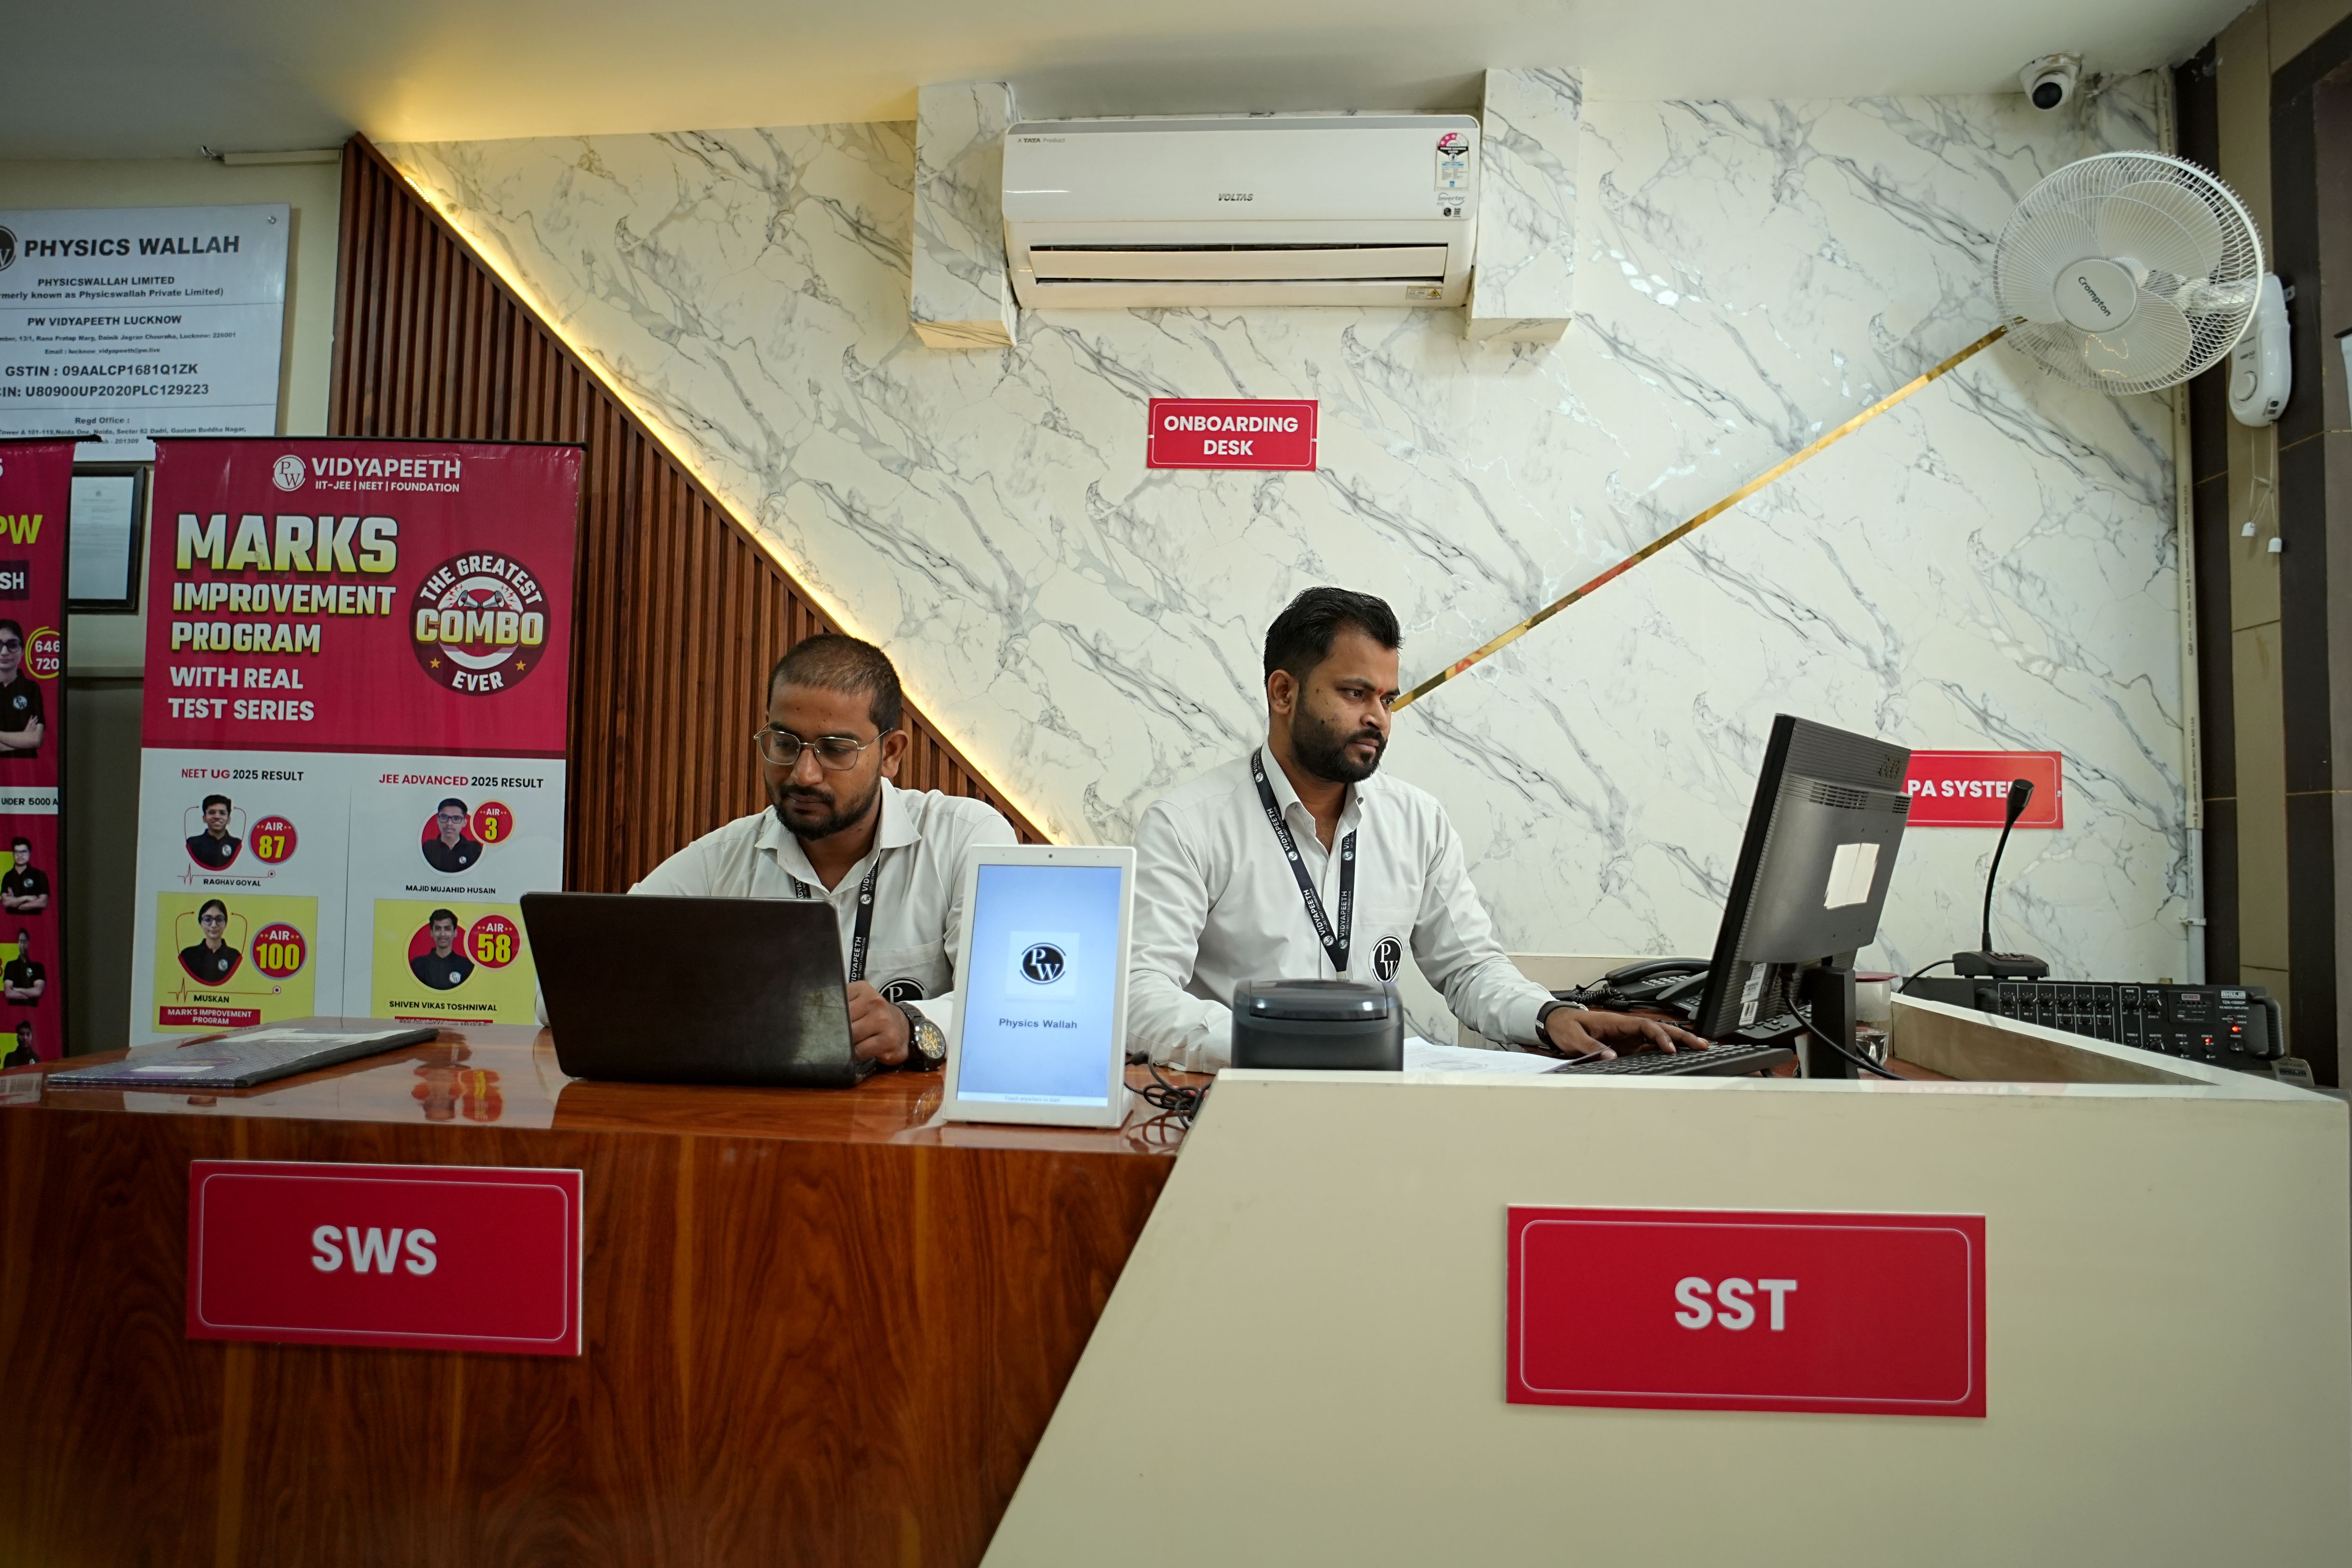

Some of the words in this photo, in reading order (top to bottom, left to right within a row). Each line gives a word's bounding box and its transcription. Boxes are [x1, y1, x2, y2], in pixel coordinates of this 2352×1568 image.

[25, 238, 130, 257] PHYSICS
[139, 235, 240, 255] WALLAH
[38, 278, 128, 287] PHYSICSWALLAH
[131, 276, 175, 285] LIMITED
[79, 290, 146, 300] Physicswallah
[185, 287, 223, 297] Limited)
[2078, 277, 2111, 317] Crompton
[28, 318, 46, 326] PW
[49, 317, 120, 326] VIDYAPEETH
[124, 316, 182, 325] LUCKNOW
[5, 366, 49, 377] GSTIN
[1164, 416, 1298, 432] ONBOARDING
[1204, 440, 1253, 455] DESK
[312, 457, 461, 479] VIDYAPEETH
[316, 481, 351, 490] IIT-JEE
[359, 481, 383, 491] NEET
[391, 482, 460, 493] FOUNDATION
[175, 514, 398, 573] MARKS
[420, 566, 456, 602] THE
[459, 555, 542, 605] GREATEST
[173, 582, 396, 615] IMPROVEMENT
[416, 608, 544, 646] COMBO
[171, 621, 321, 653] PROGRAM
[36, 658, 60, 670] 720
[170, 666, 238, 688] WITH
[244, 668, 303, 689] REAL
[452, 670, 504, 692] EVER
[168, 698, 228, 719] TEST
[233, 700, 315, 721] SERIES
[181, 768, 208, 779] NEET
[211, 769, 230, 780] UG
[233, 769, 258, 780] 2025
[262, 770, 304, 781] RESULT
[379, 773, 399, 784] JEE
[402, 774, 469, 786] ADVANCED
[471, 777, 499, 787] 2025
[501, 777, 544, 788] RESULT
[1907, 780, 1937, 797] PA
[1941, 780, 2013, 798] SYSTE
[486, 808, 500, 816] AIR
[265, 822, 283, 832] AIR
[485, 818, 498, 840] 3
[1267, 808, 1290, 851] VIDYAPEETH
[259, 835, 286, 859] 87
[203, 878, 234, 886] RAGHAV
[405, 884, 429, 893] MAJID
[430, 885, 465, 894] MUJAHID
[1303, 889, 1326, 936] VIDYAPEETH
[270, 930, 290, 941] AIR
[486, 923, 504, 933] AIR
[256, 943, 300, 970] 100
[477, 933, 511, 963] 58
[194, 994, 230, 1003] MUSKAN
[889, 986, 903, 1003] P
[199, 1010, 252, 1018] IMPROVEMENT
[389, 1000, 420, 1009] SHIVEN
[447, 1003, 497, 1011] TOSHNIWAL
[999, 1018, 1039, 1028] Physics
[1043, 1020, 1077, 1029] Wallah
[312, 1225, 438, 1276] SWS
[1674, 1276, 1797, 1332] SST
